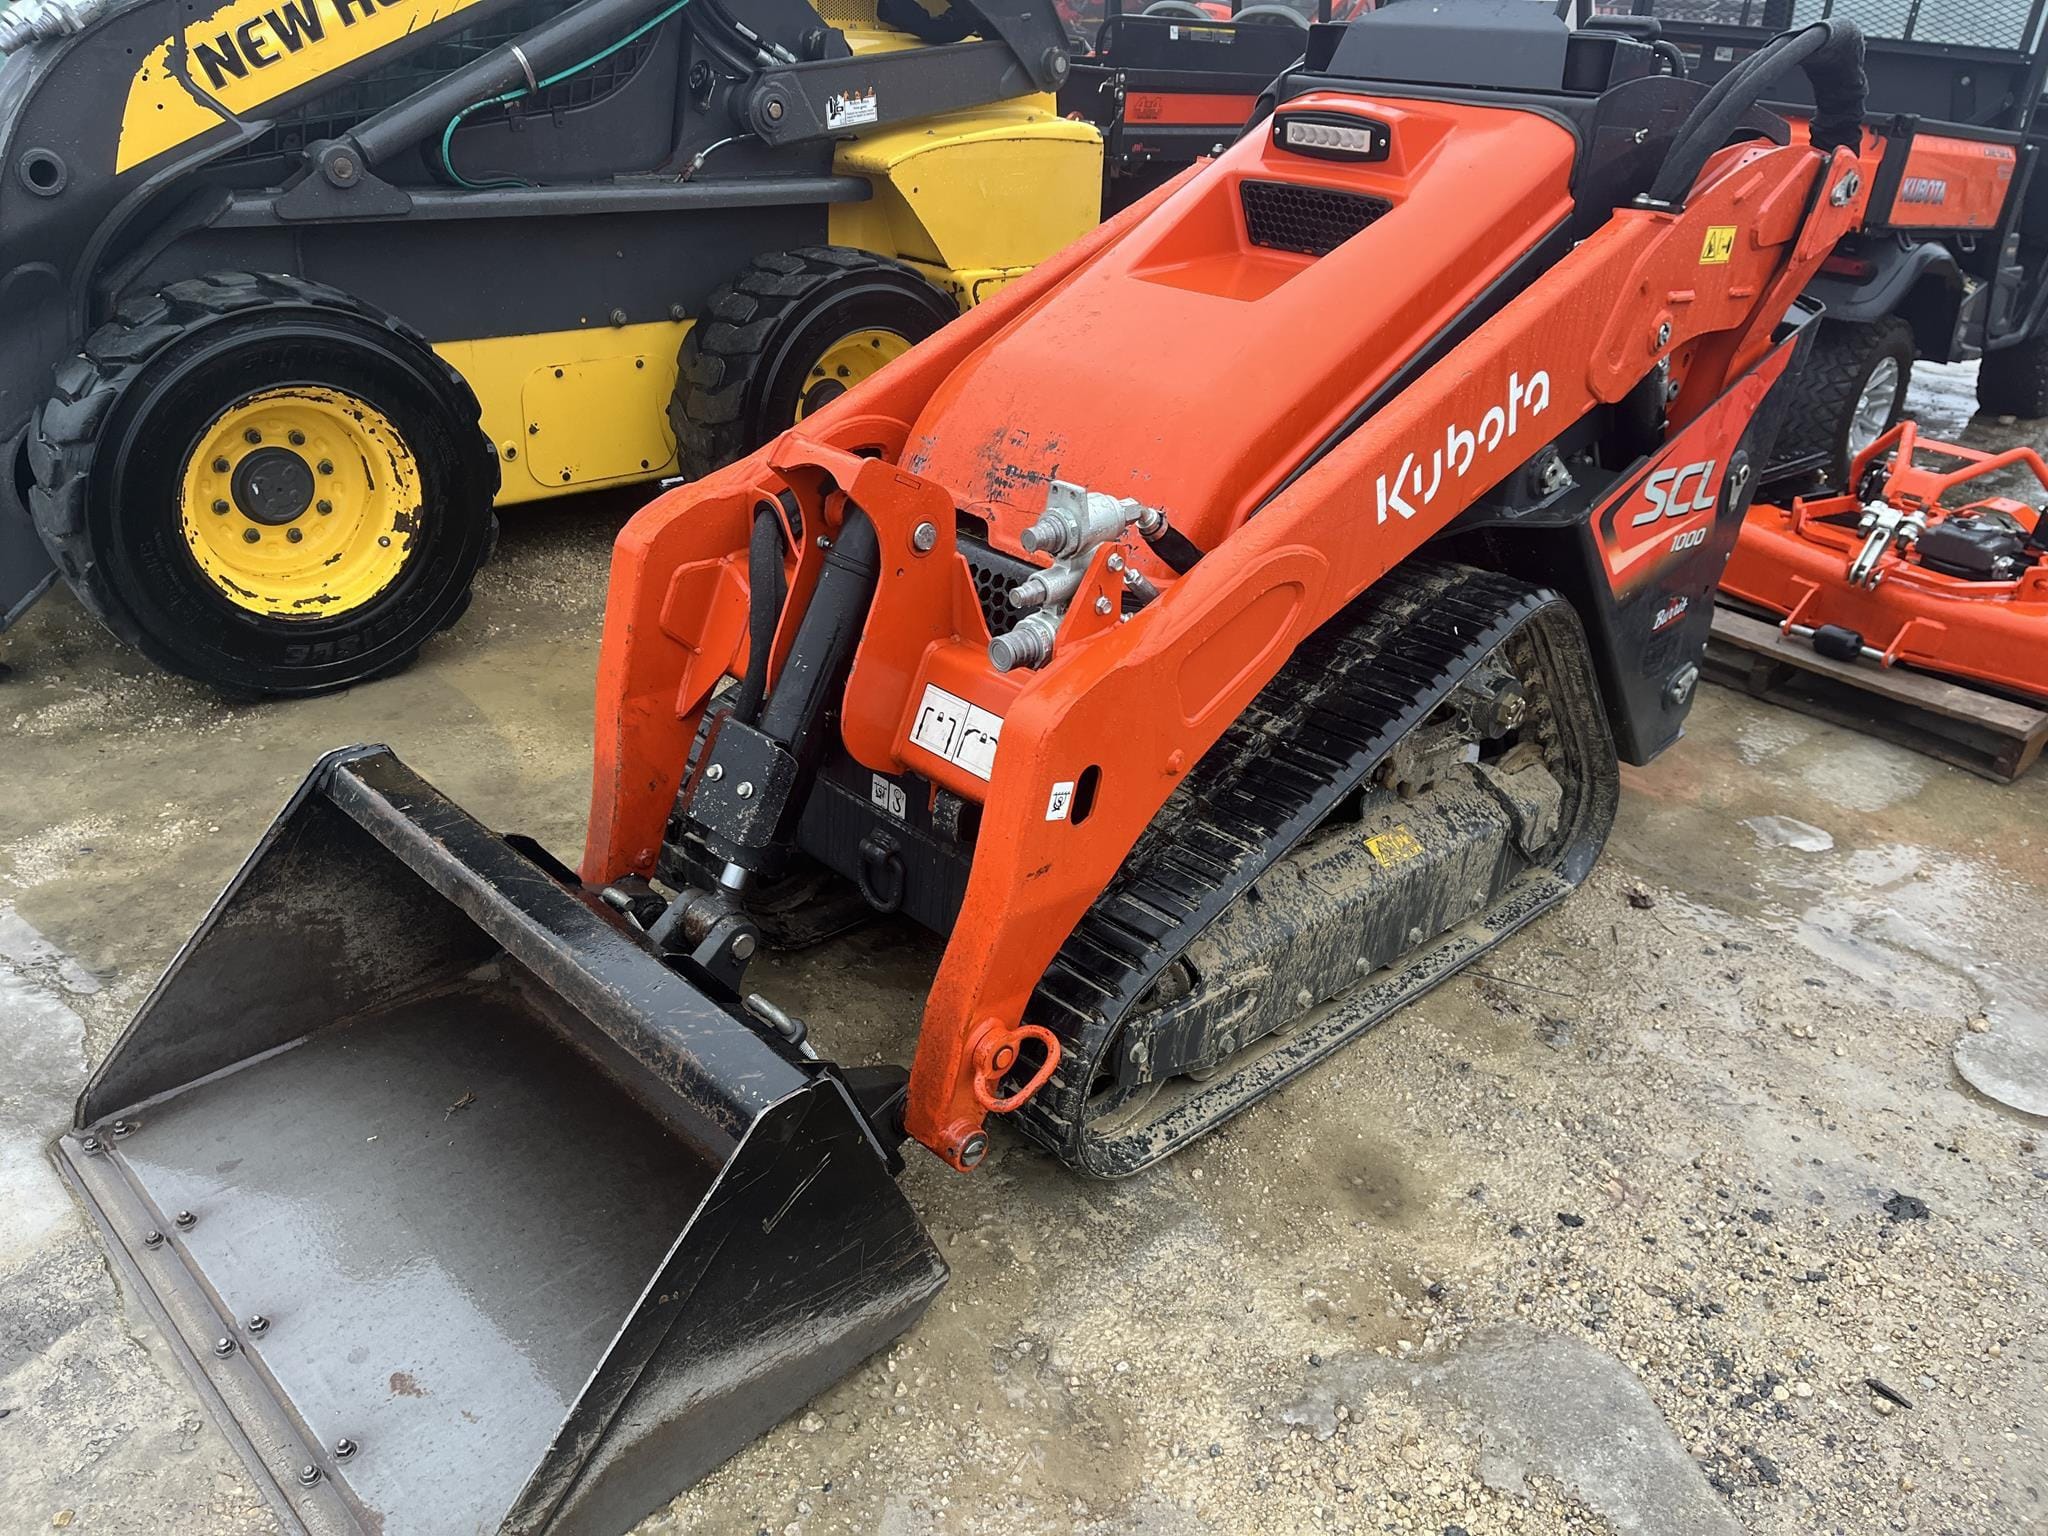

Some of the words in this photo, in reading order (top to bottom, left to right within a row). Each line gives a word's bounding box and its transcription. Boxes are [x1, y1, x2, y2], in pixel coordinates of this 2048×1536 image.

[193, 1, 325, 90] NEW
[1903, 176, 1947, 204] KUBOTA
[1376, 371, 1550, 525] Kubota
[1632, 460, 1716, 528] SCL
[1670, 527, 1707, 552] 1000
